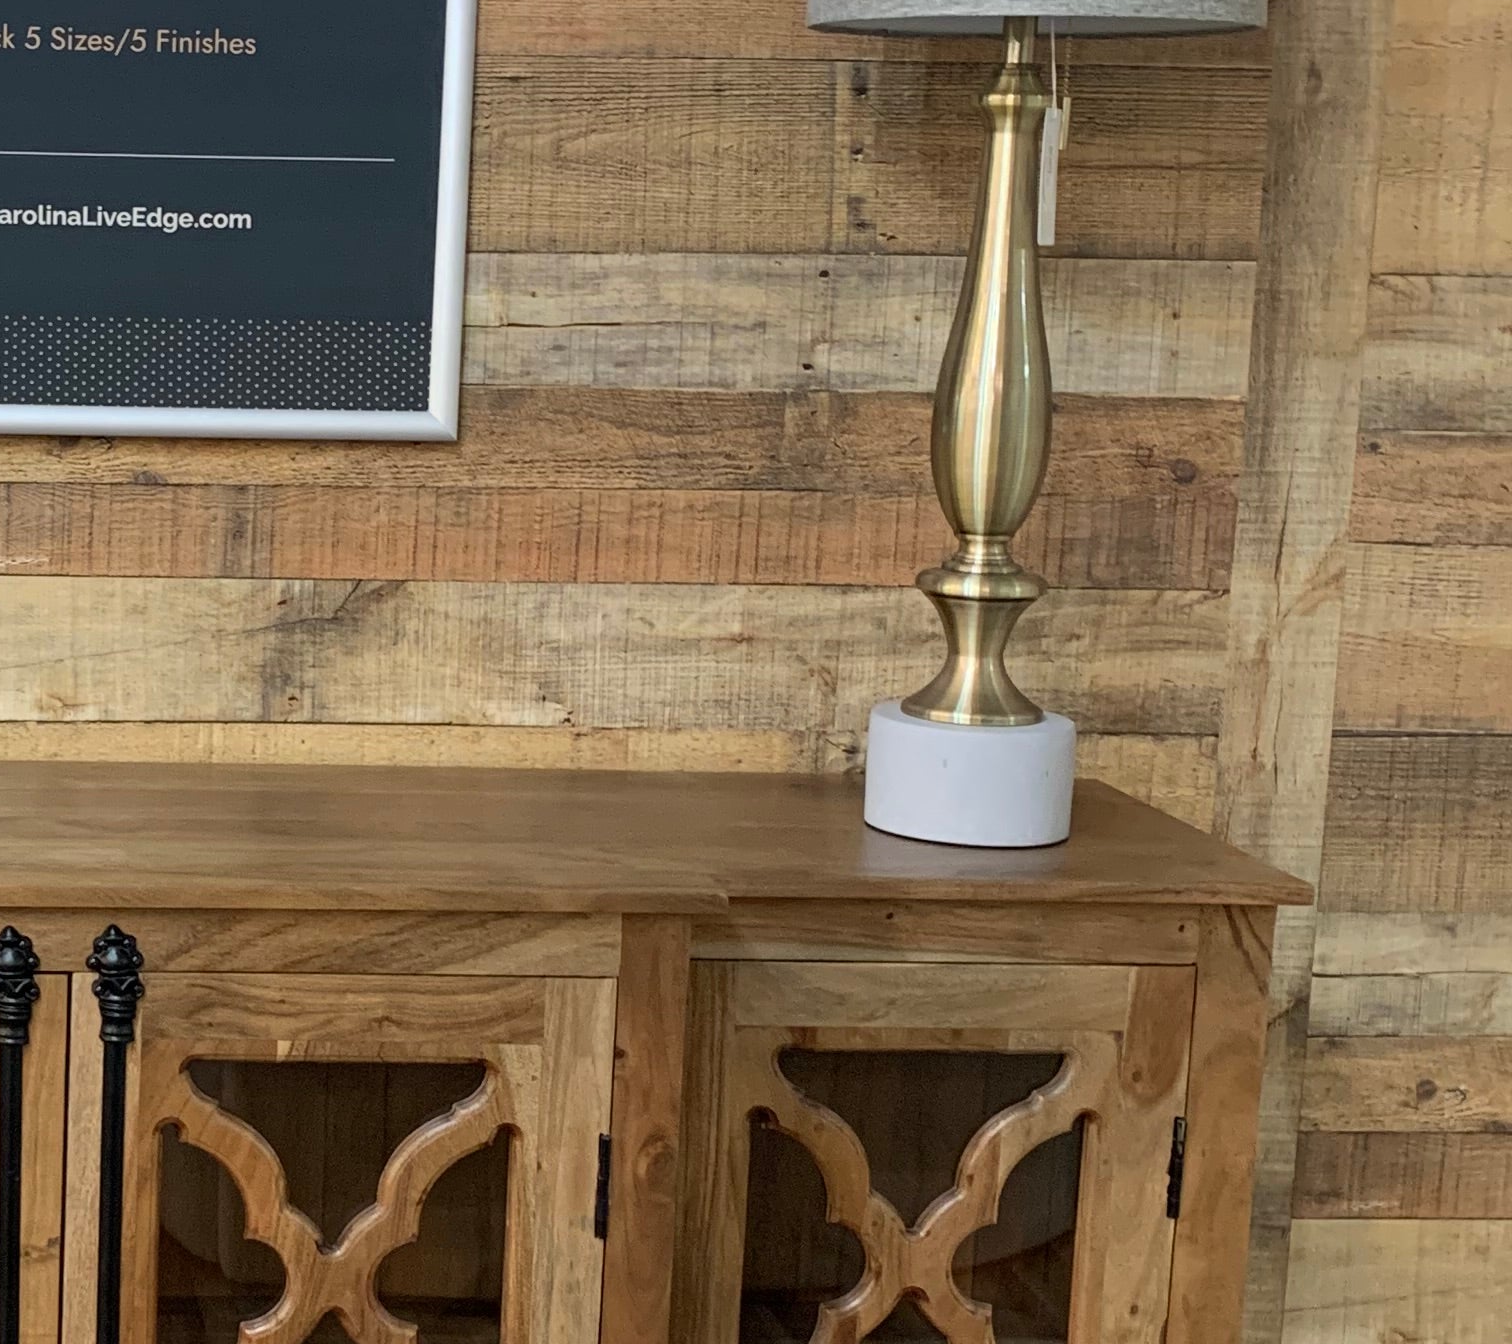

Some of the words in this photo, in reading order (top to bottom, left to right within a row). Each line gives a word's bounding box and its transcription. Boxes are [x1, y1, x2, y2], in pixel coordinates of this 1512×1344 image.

[25, 26, 41, 49] 5
[51, 27, 146, 56] Sizes/5
[157, 29, 256, 54] Finishes
